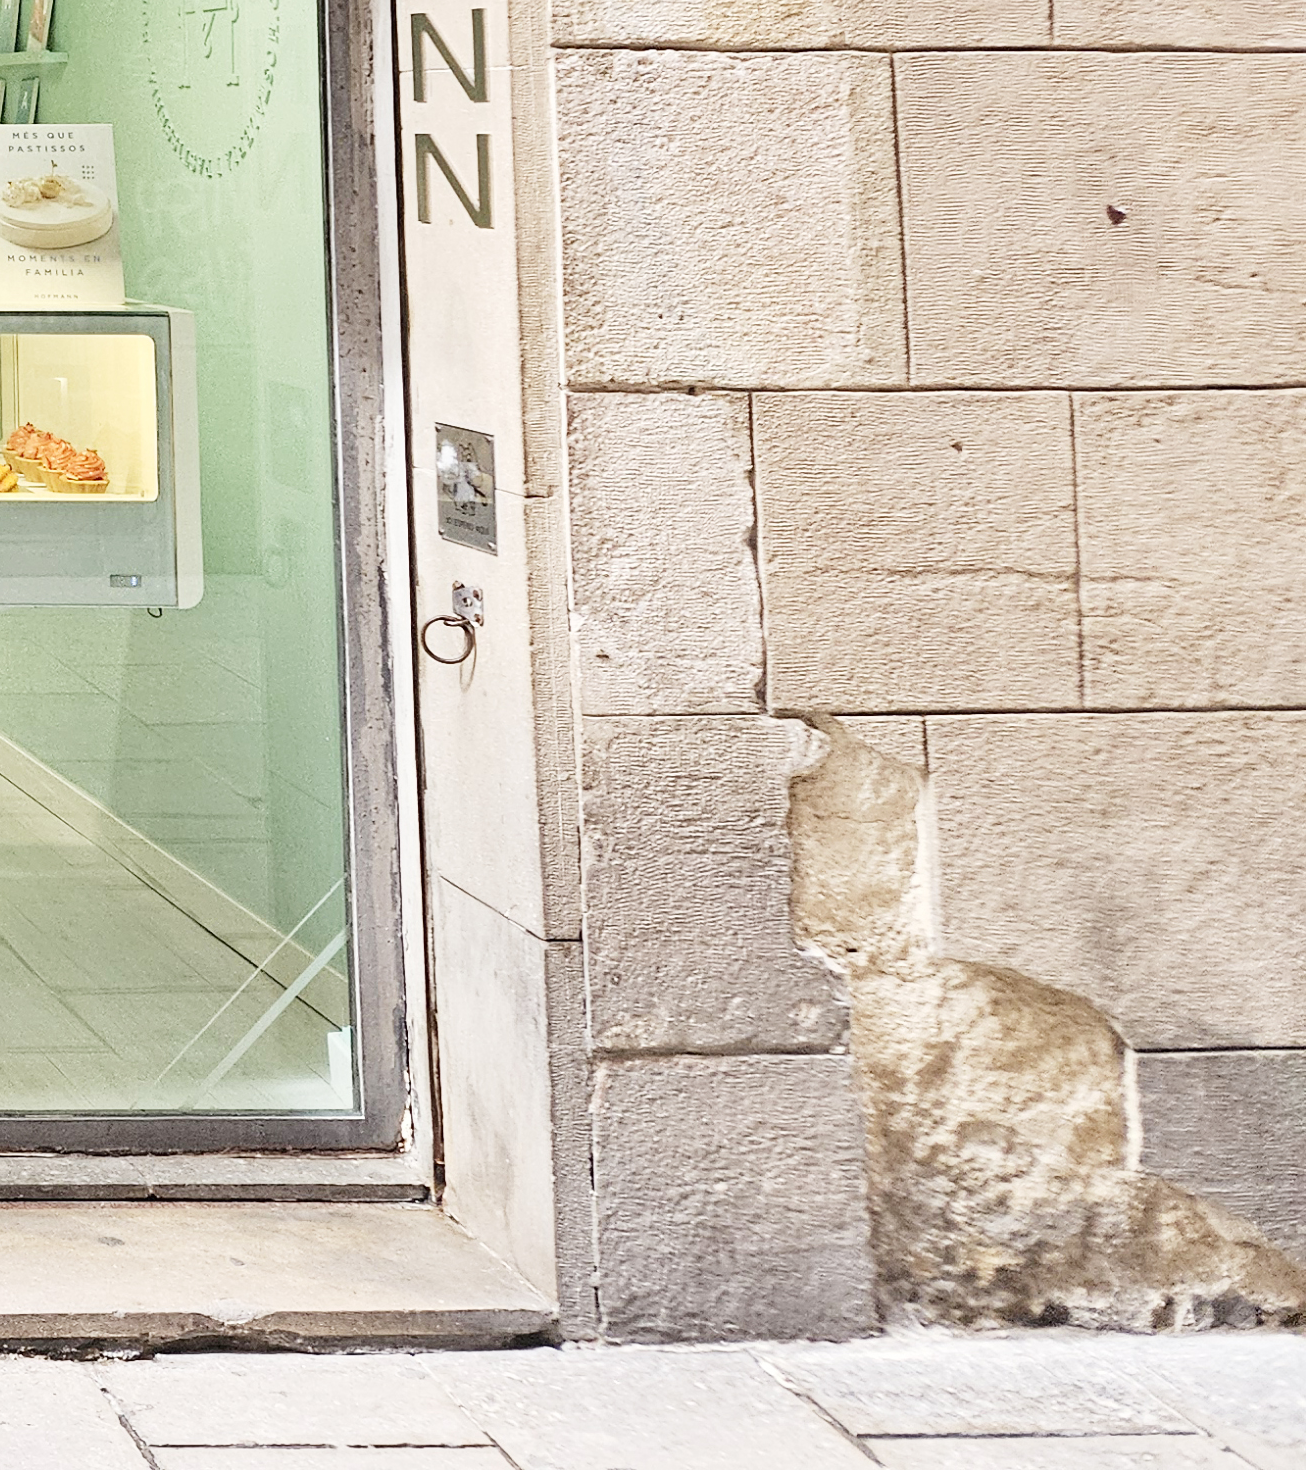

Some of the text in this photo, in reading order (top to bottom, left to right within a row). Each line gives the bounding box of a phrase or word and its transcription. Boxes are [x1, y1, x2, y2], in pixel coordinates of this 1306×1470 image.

[46, 131, 74, 140] QUE
[8, 144, 86, 153] PASTISSOS
[7, 254, 101, 263] MOMENTS EN
[25, 268, 84, 276] FAMILIA
